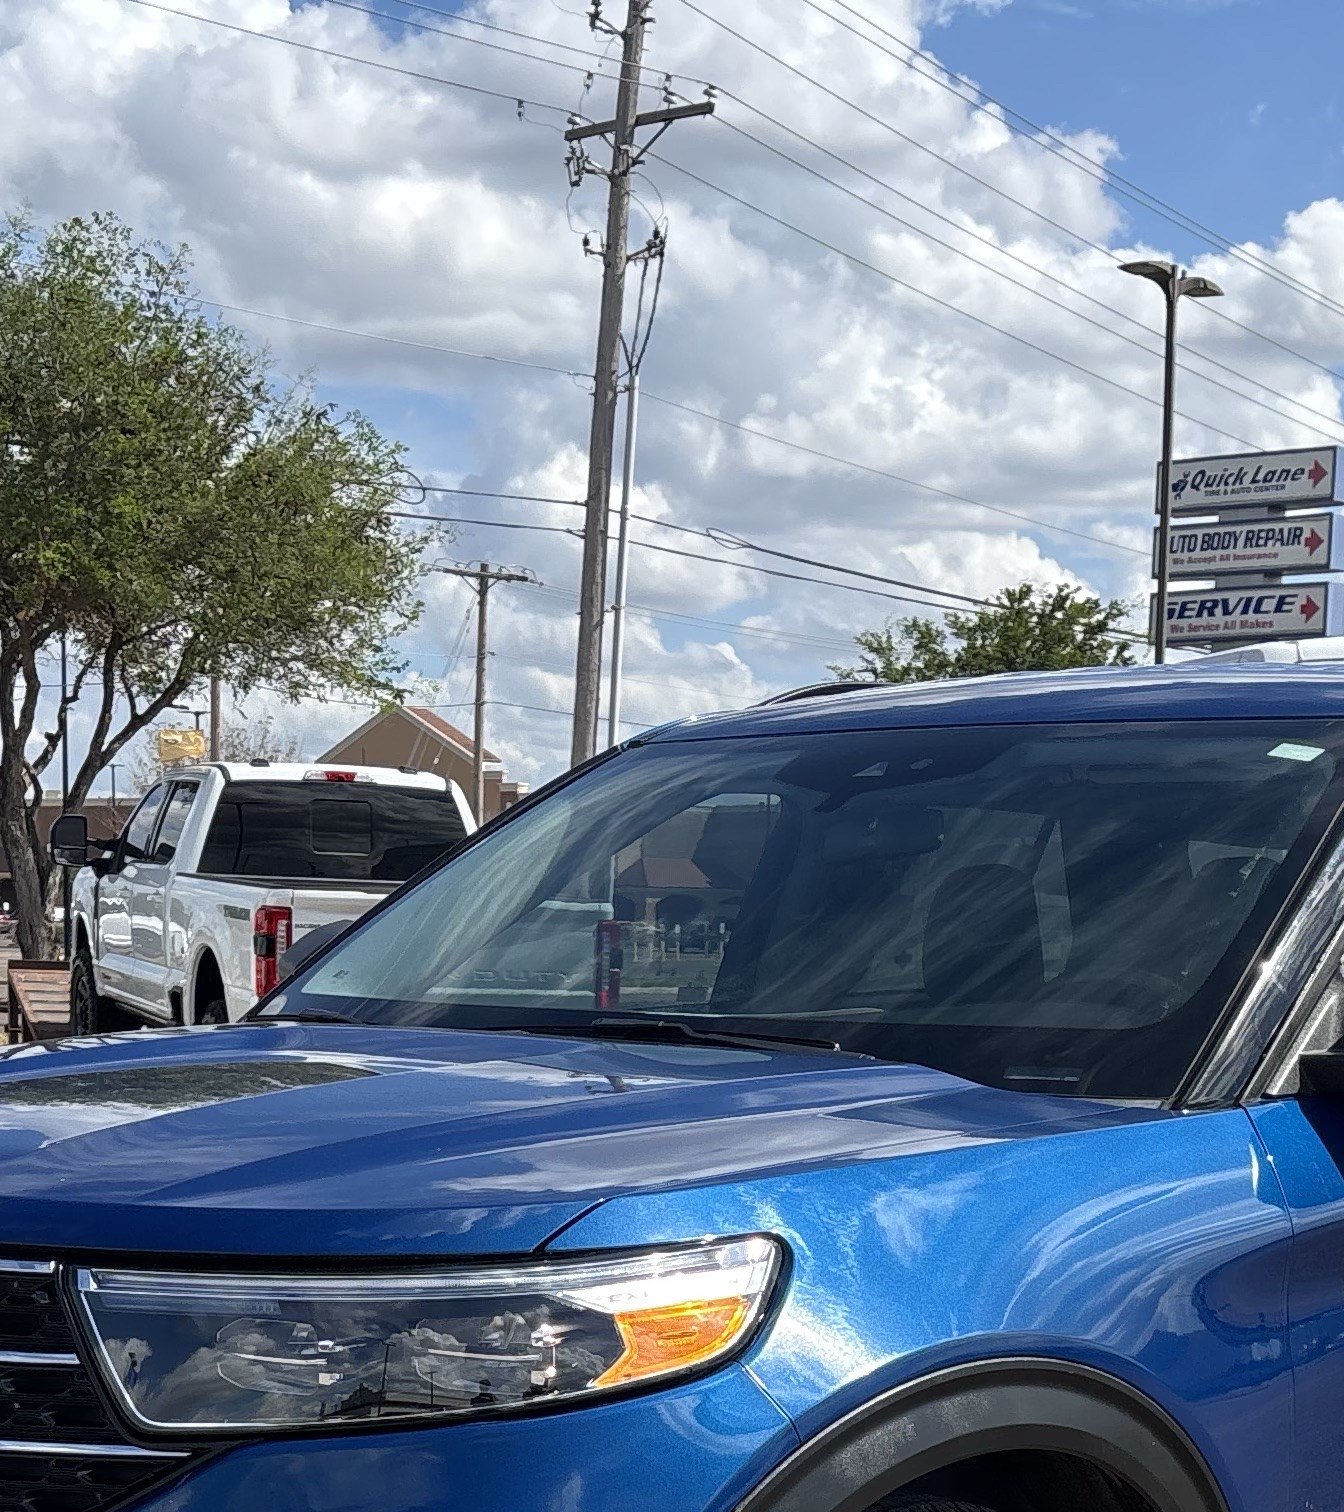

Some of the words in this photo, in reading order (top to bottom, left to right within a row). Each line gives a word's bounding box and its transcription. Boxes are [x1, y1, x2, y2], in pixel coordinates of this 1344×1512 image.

[1190, 466, 1249, 491] Quick
[1249, 464, 1305, 485] Lane
[1168, 534, 1199, 554] UTO
[1199, 530, 1244, 552] BODY
[1243, 526, 1304, 549] REPAIR
[1187, 554, 1217, 565] Accept
[1232, 551, 1279, 561] Insurance
[1187, 621, 1221, 633] Service
[1223, 620, 1237, 631] All
[1239, 618, 1274, 630] Makes
